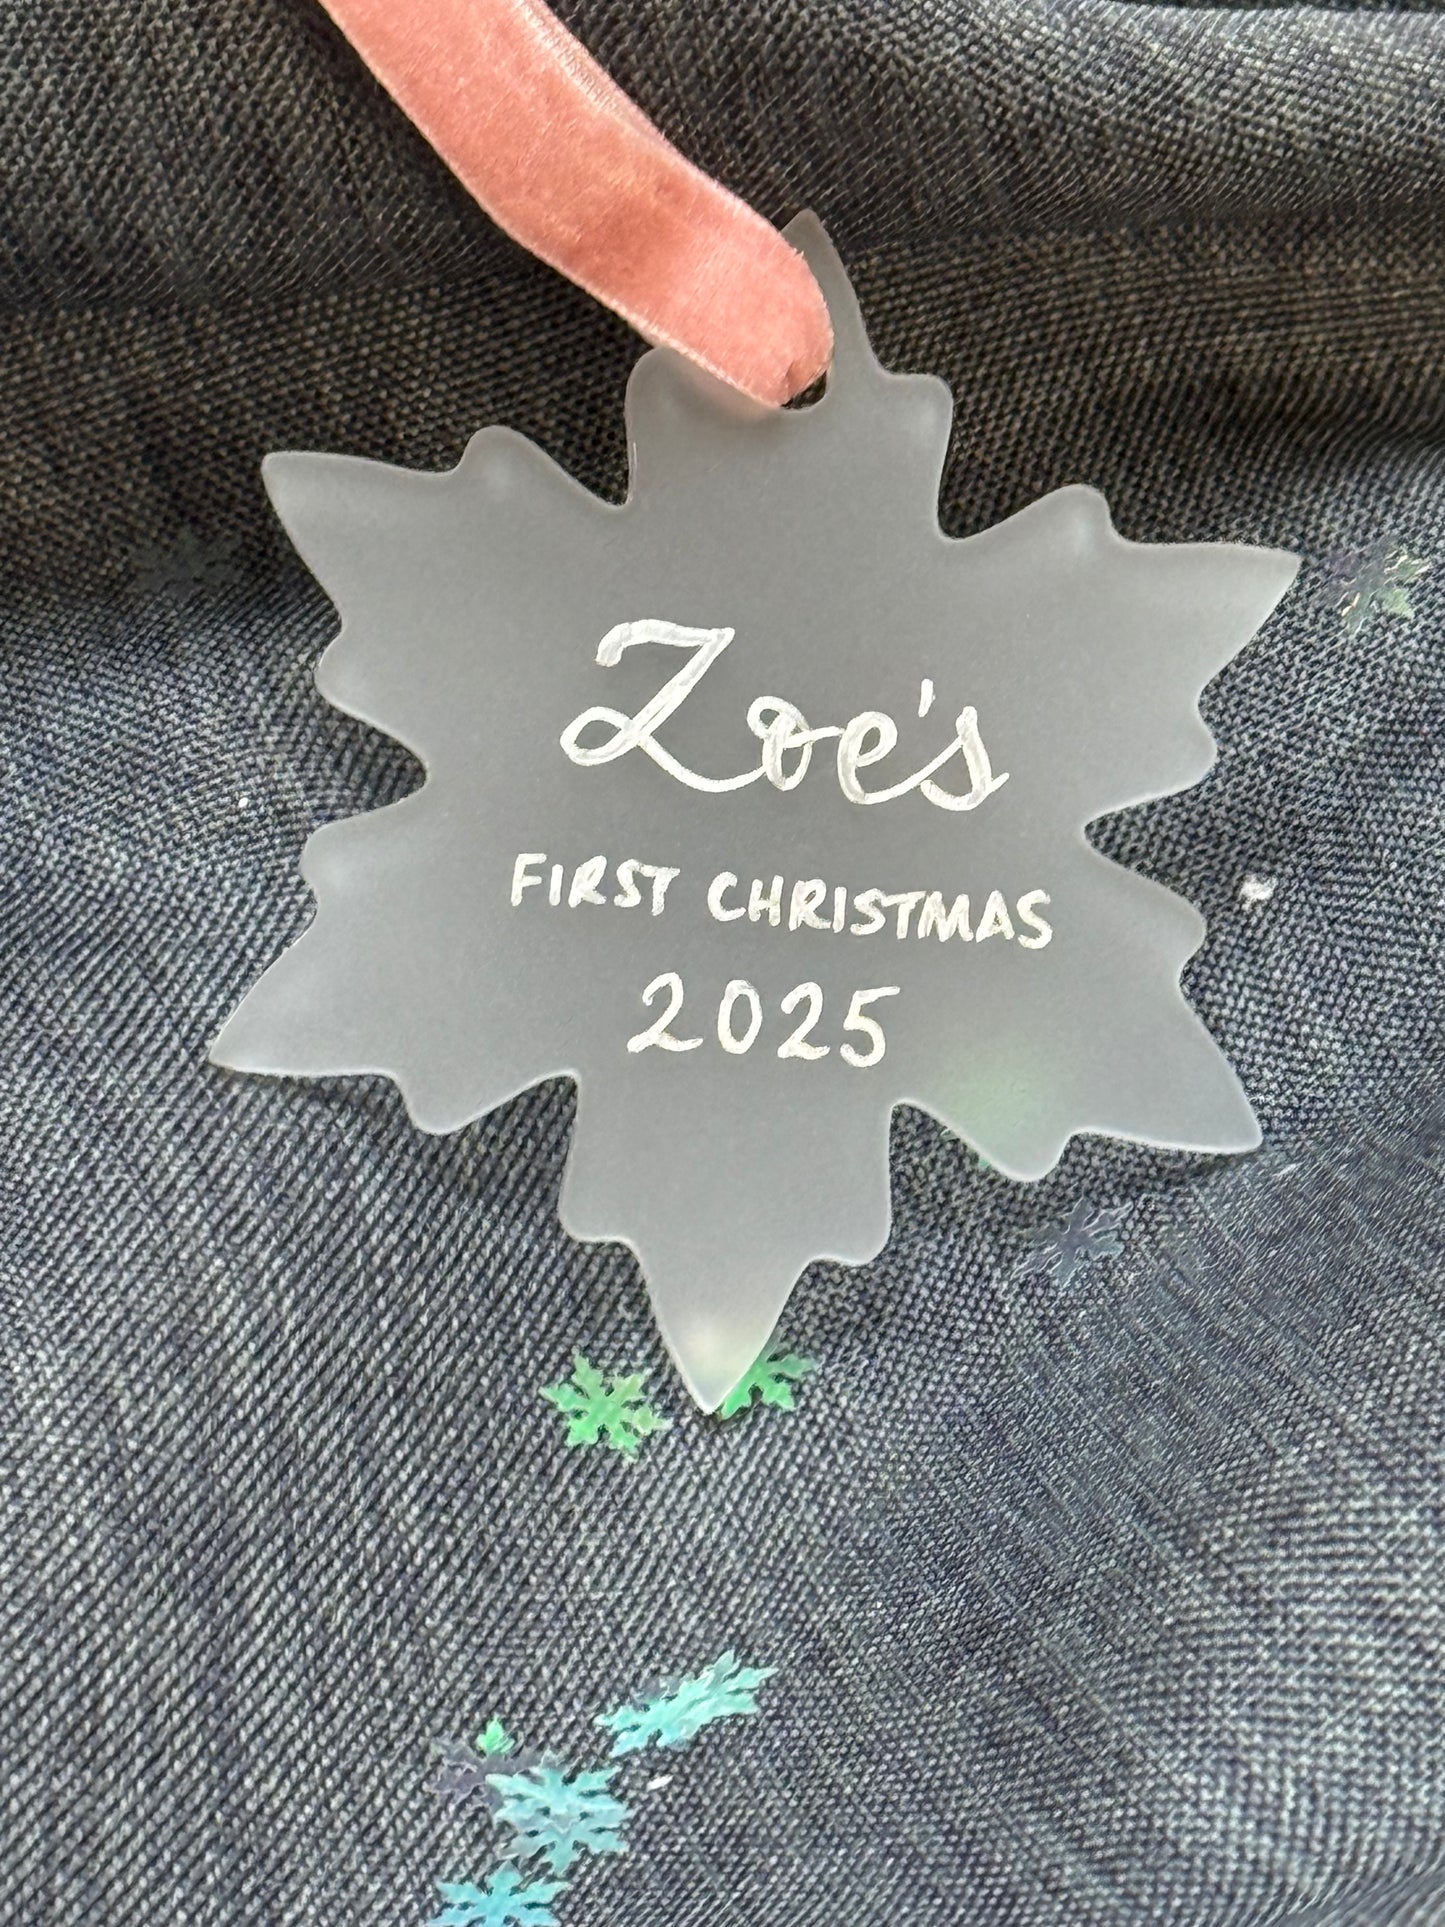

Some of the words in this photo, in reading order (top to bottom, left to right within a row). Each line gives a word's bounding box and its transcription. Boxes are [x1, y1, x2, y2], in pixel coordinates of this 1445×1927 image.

[559, 618, 1010, 812] Zoe's
[510, 852, 680, 916] FIRST
[706, 871, 1054, 950] CHRISTMAS
[626, 971, 901, 1068] 2025
